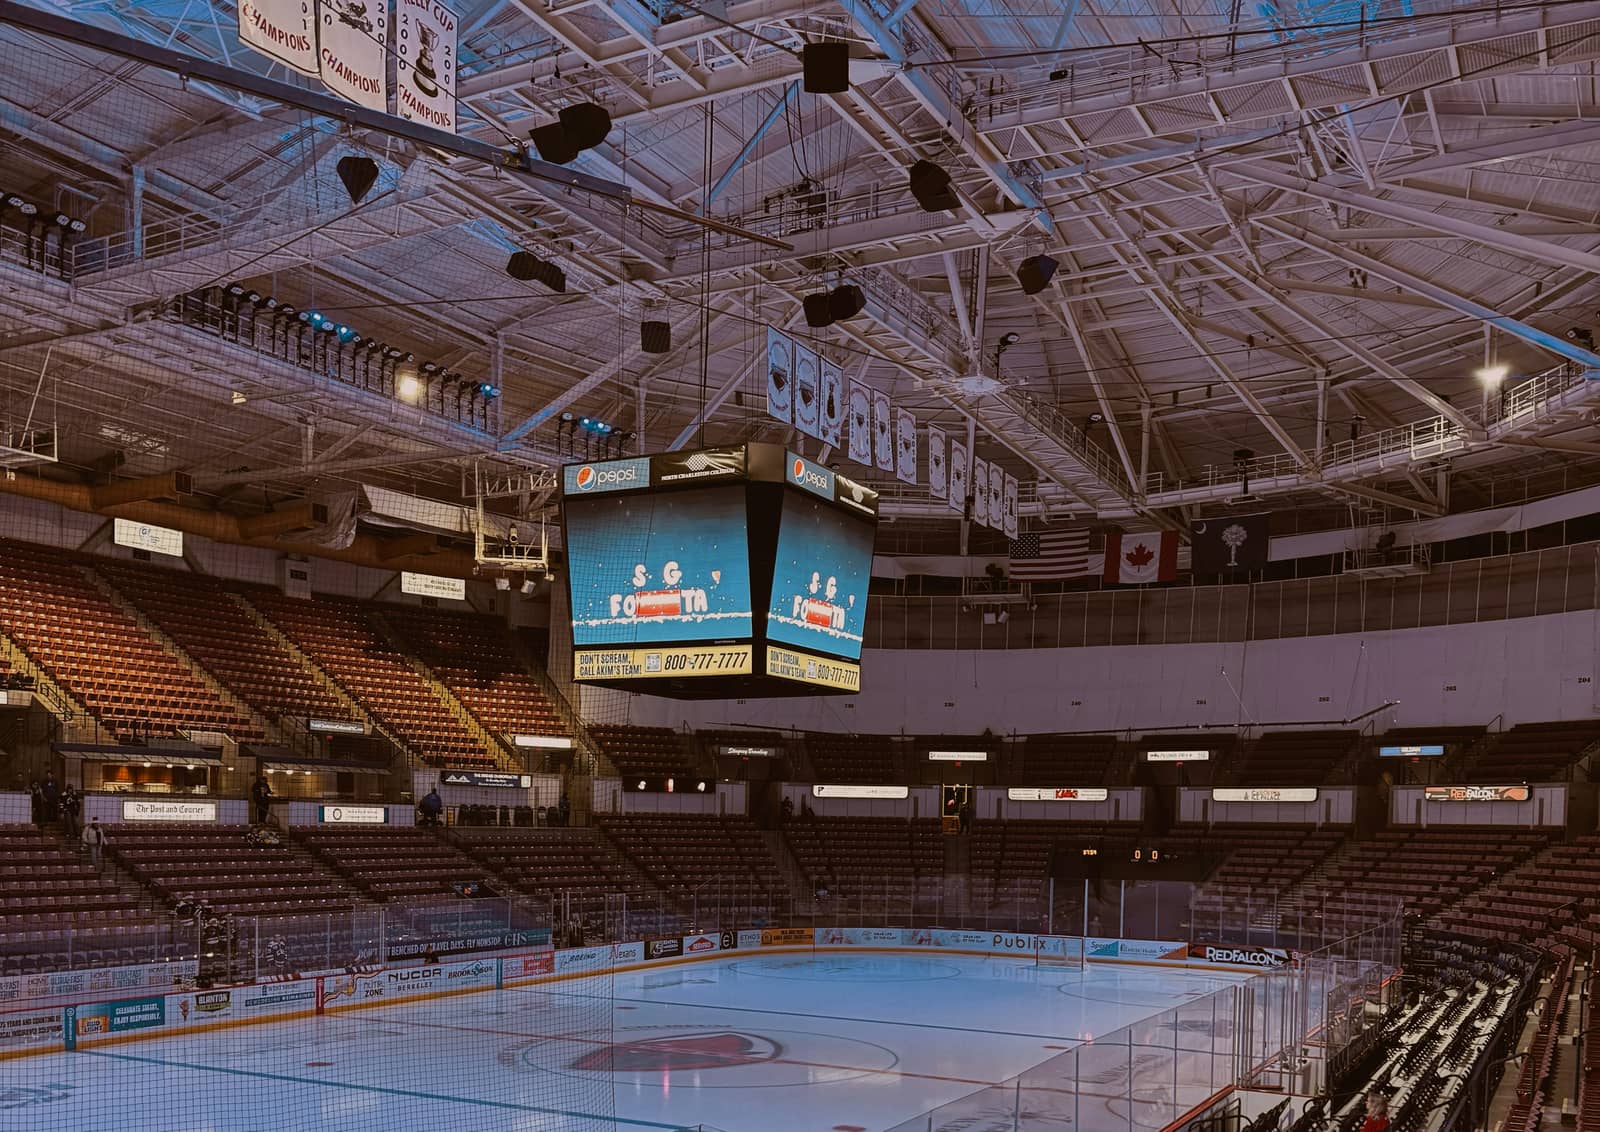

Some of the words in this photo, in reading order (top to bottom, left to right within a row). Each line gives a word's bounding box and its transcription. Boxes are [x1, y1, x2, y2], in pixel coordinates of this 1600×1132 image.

[433, 6, 454, 32] CUP
[243, 4, 310, 51] CHAMPIONS
[322, 48, 380, 94] CHAMPIONS
[399, 84, 451, 127] CHAMPIONS
[597, 467, 637, 487] pepsi
[805, 471, 828, 489] pepsi
[580, 654, 601, 664] DON'T
[579, 666, 596, 676] CALL
[597, 665, 621, 675] AKIM'S
[621, 664, 642, 675] TEAM!
[136, 804, 149, 813] The
[150, 804, 164, 813] Post
[166, 804, 178, 813] and
[179, 804, 203, 814] Courier
[993, 934, 1046, 950] Publix
[391, 944, 419, 956] BENCHED
[388, 968, 442, 982] NUCOR
[365, 988, 384, 998] ZONE
[397, 982, 432, 992] BERKELEY
